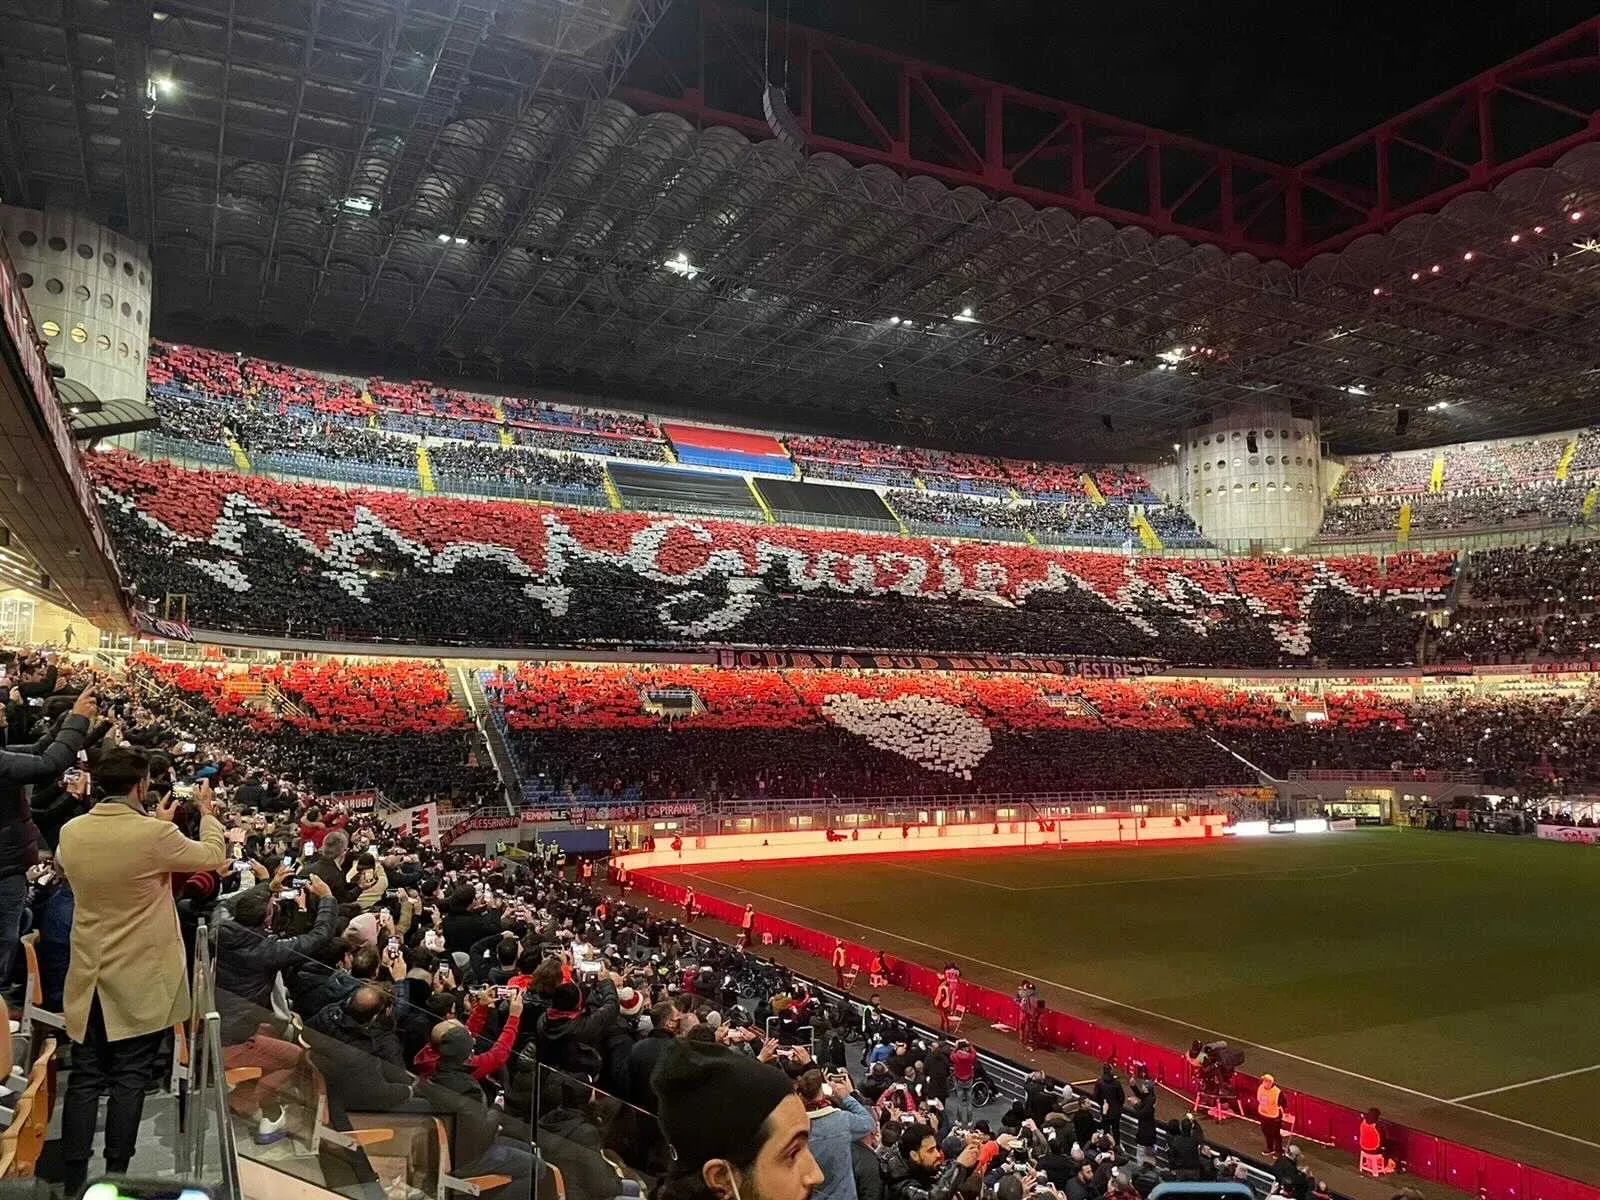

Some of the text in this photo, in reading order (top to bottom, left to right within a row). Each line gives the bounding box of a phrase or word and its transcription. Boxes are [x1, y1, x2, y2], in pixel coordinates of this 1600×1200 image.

[740, 651, 1065, 674] CURVA SUD MILANO
[520, 810, 567, 822] FEMMINILE
[660, 803, 697, 816] PIRANHA
